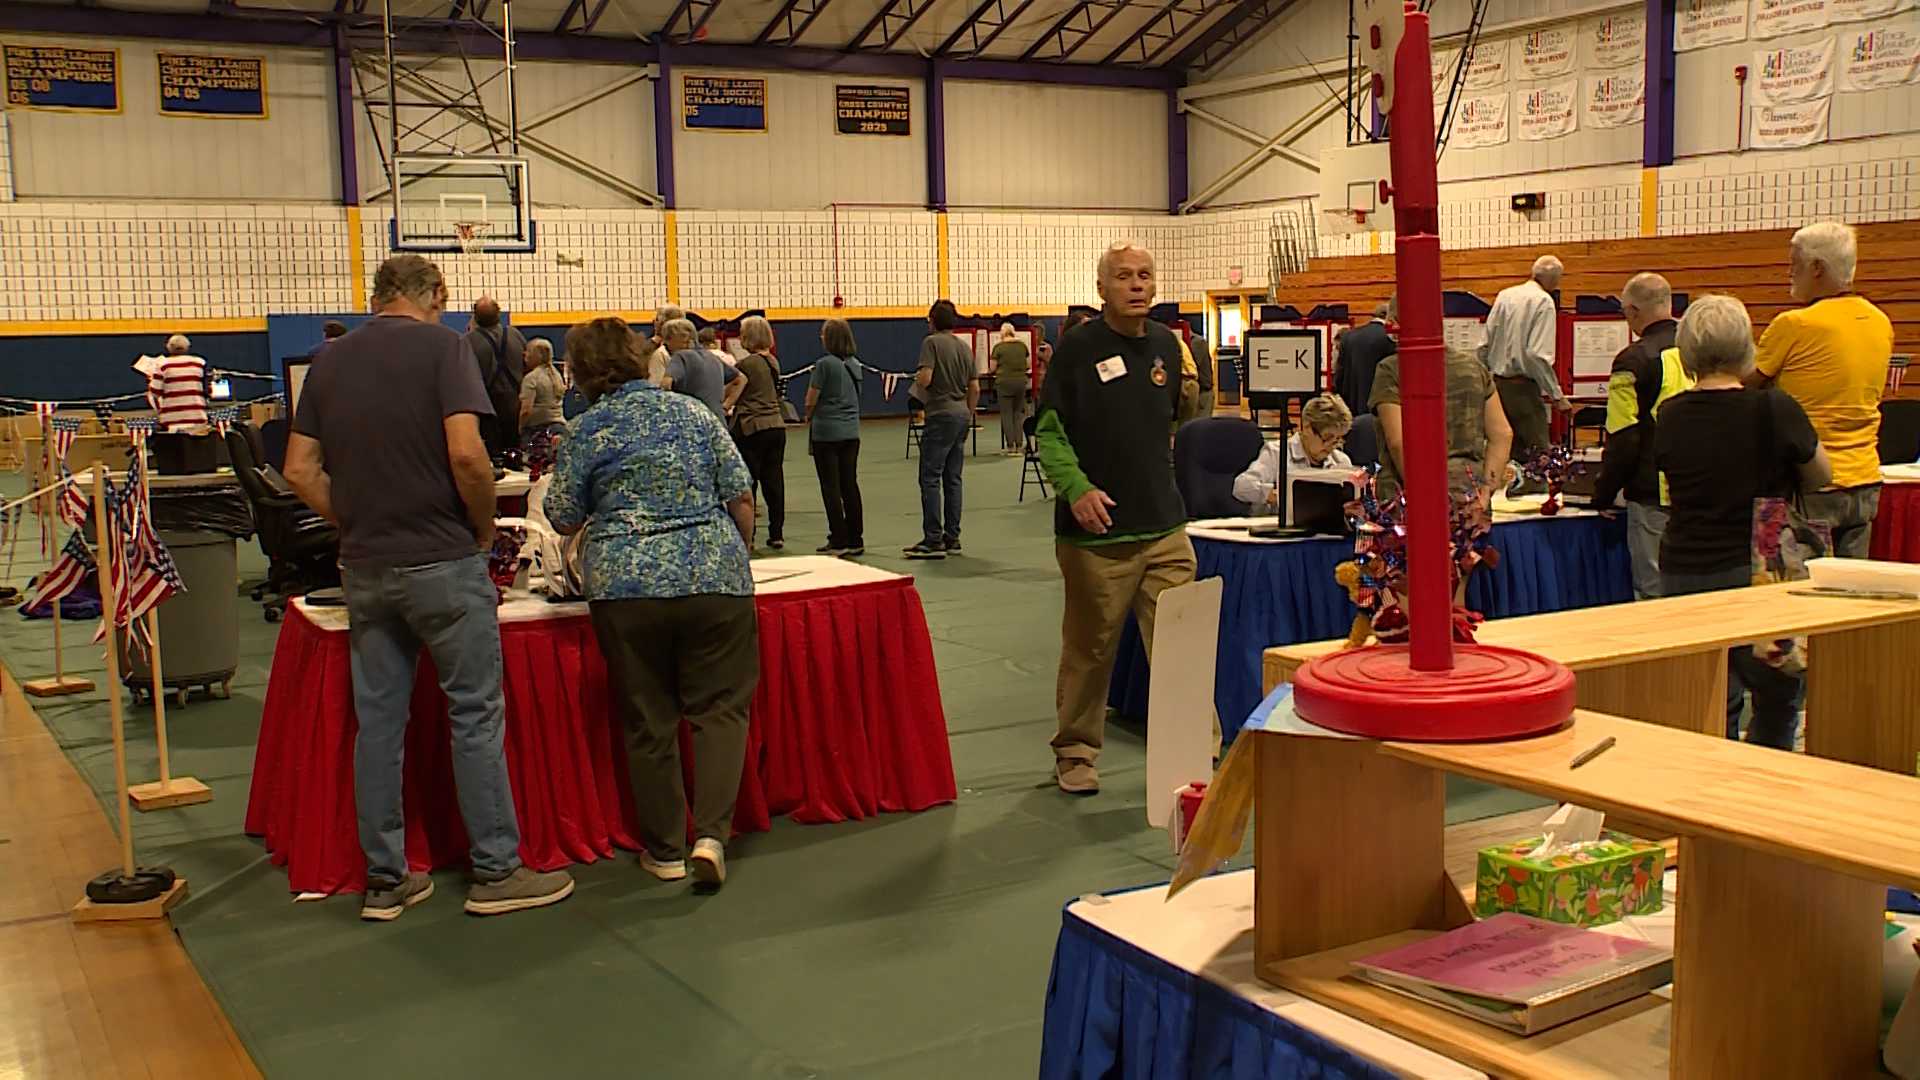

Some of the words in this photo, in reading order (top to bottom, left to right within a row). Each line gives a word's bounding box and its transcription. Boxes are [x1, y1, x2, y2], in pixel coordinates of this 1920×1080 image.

[9, 67, 112, 82] CHAMPIONS
[162, 75, 259, 90] CHAMPIONS
[686, 95, 764, 106] CHAMPIONS
[867, 101, 908, 110] COUNTRY
[839, 109, 908, 120] CHAMPIONS
[1257, 349, 1270, 369] E
[1295, 349, 1309, 369] K
